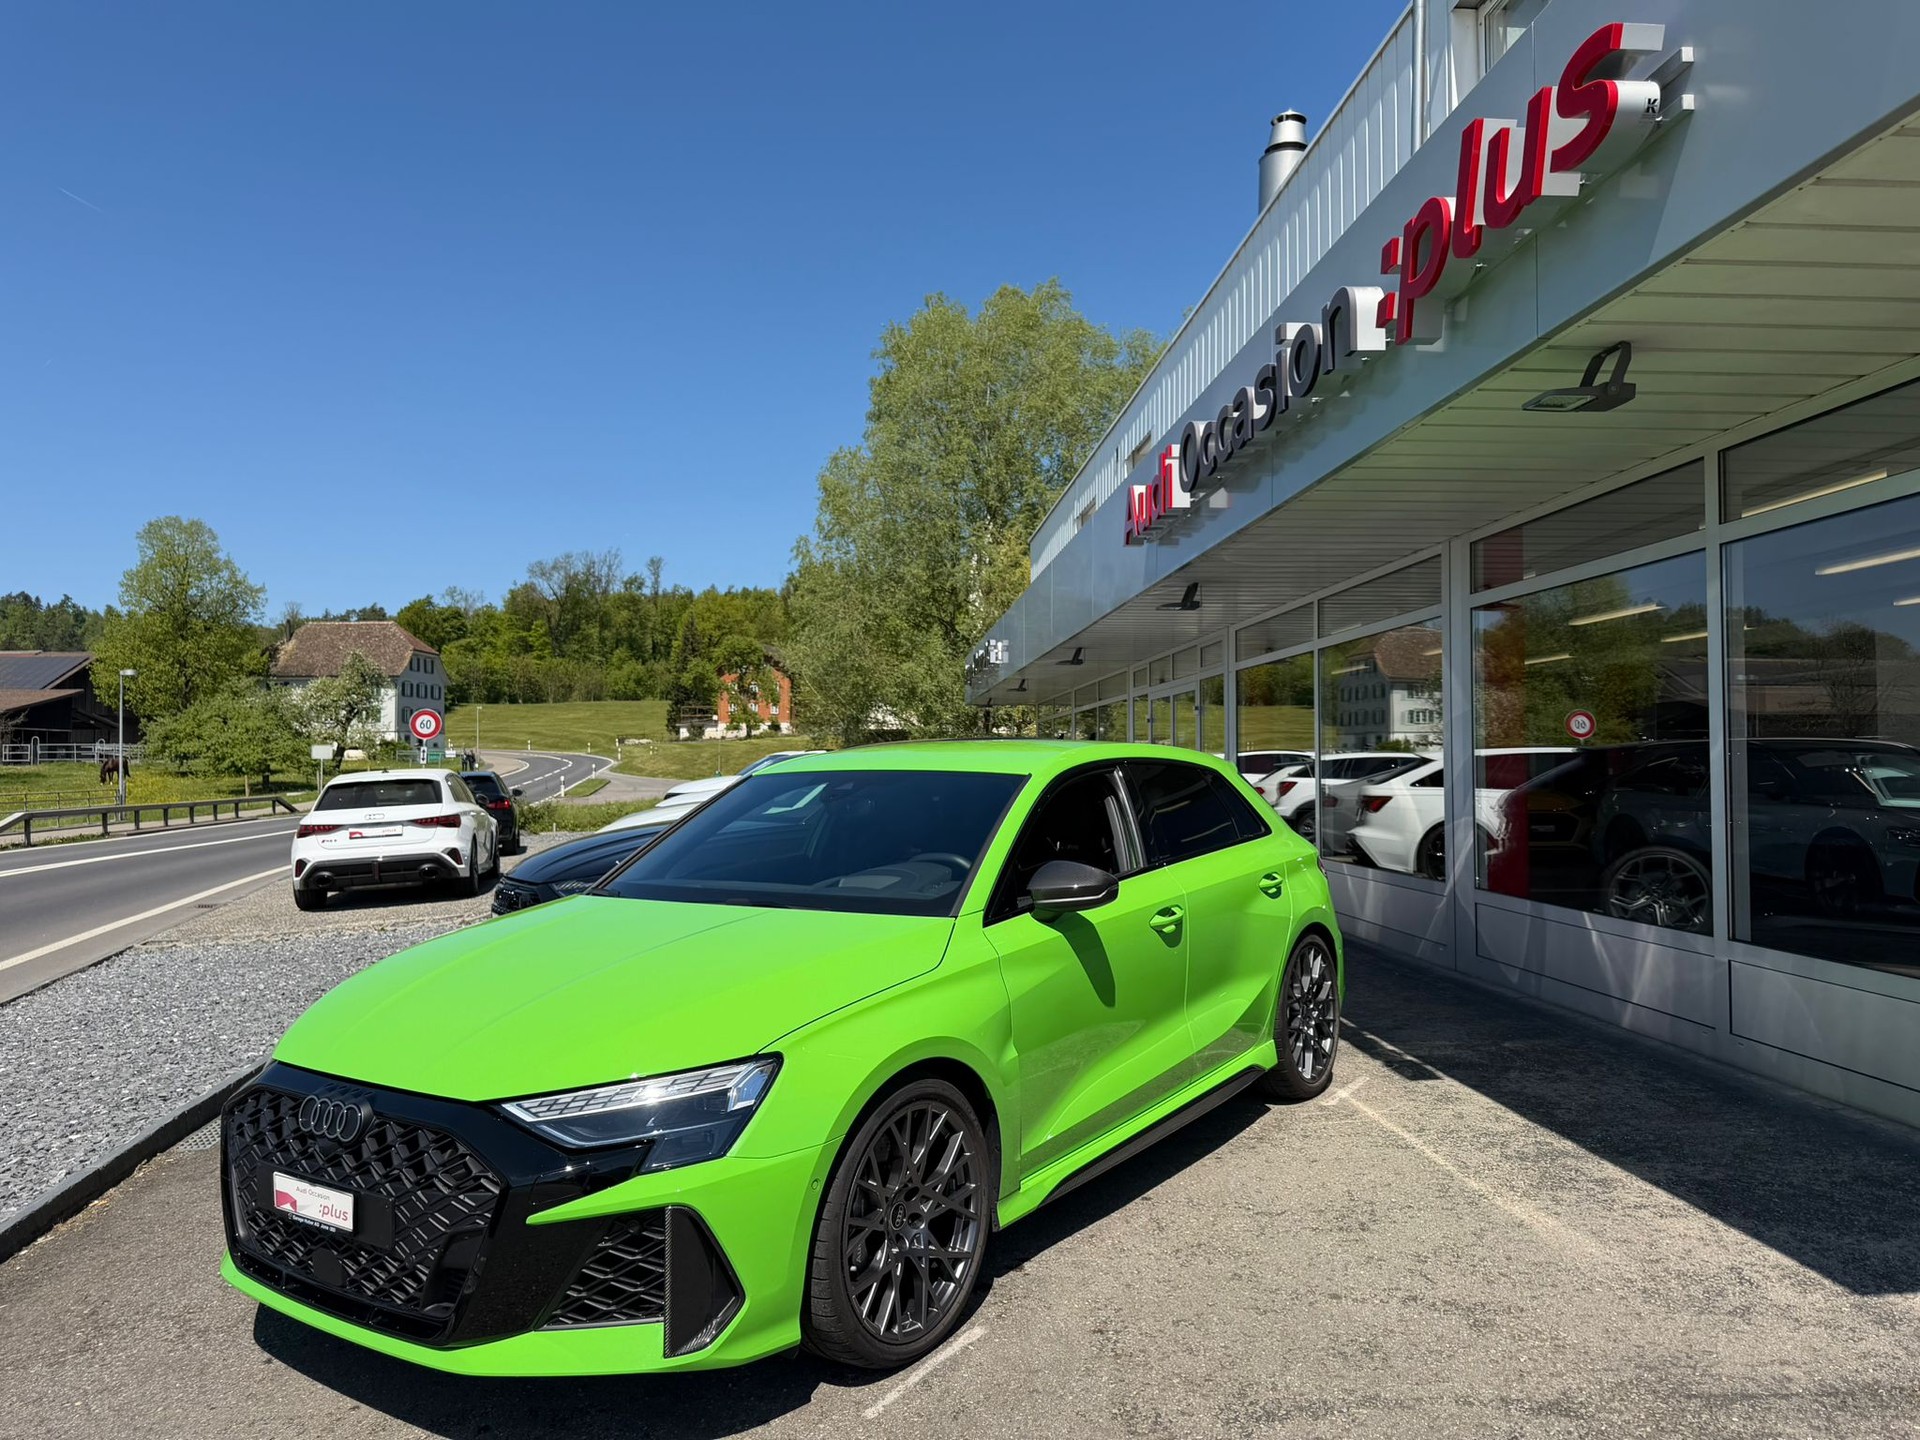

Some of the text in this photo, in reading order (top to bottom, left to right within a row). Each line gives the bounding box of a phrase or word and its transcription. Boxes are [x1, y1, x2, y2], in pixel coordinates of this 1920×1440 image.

[1124, 22, 1632, 546] Audi Occasion :plus
[420, 720, 432, 730] 60
[296, 1186, 330, 1200] Audi Occasion
[319, 1203, 349, 1222] :plus
